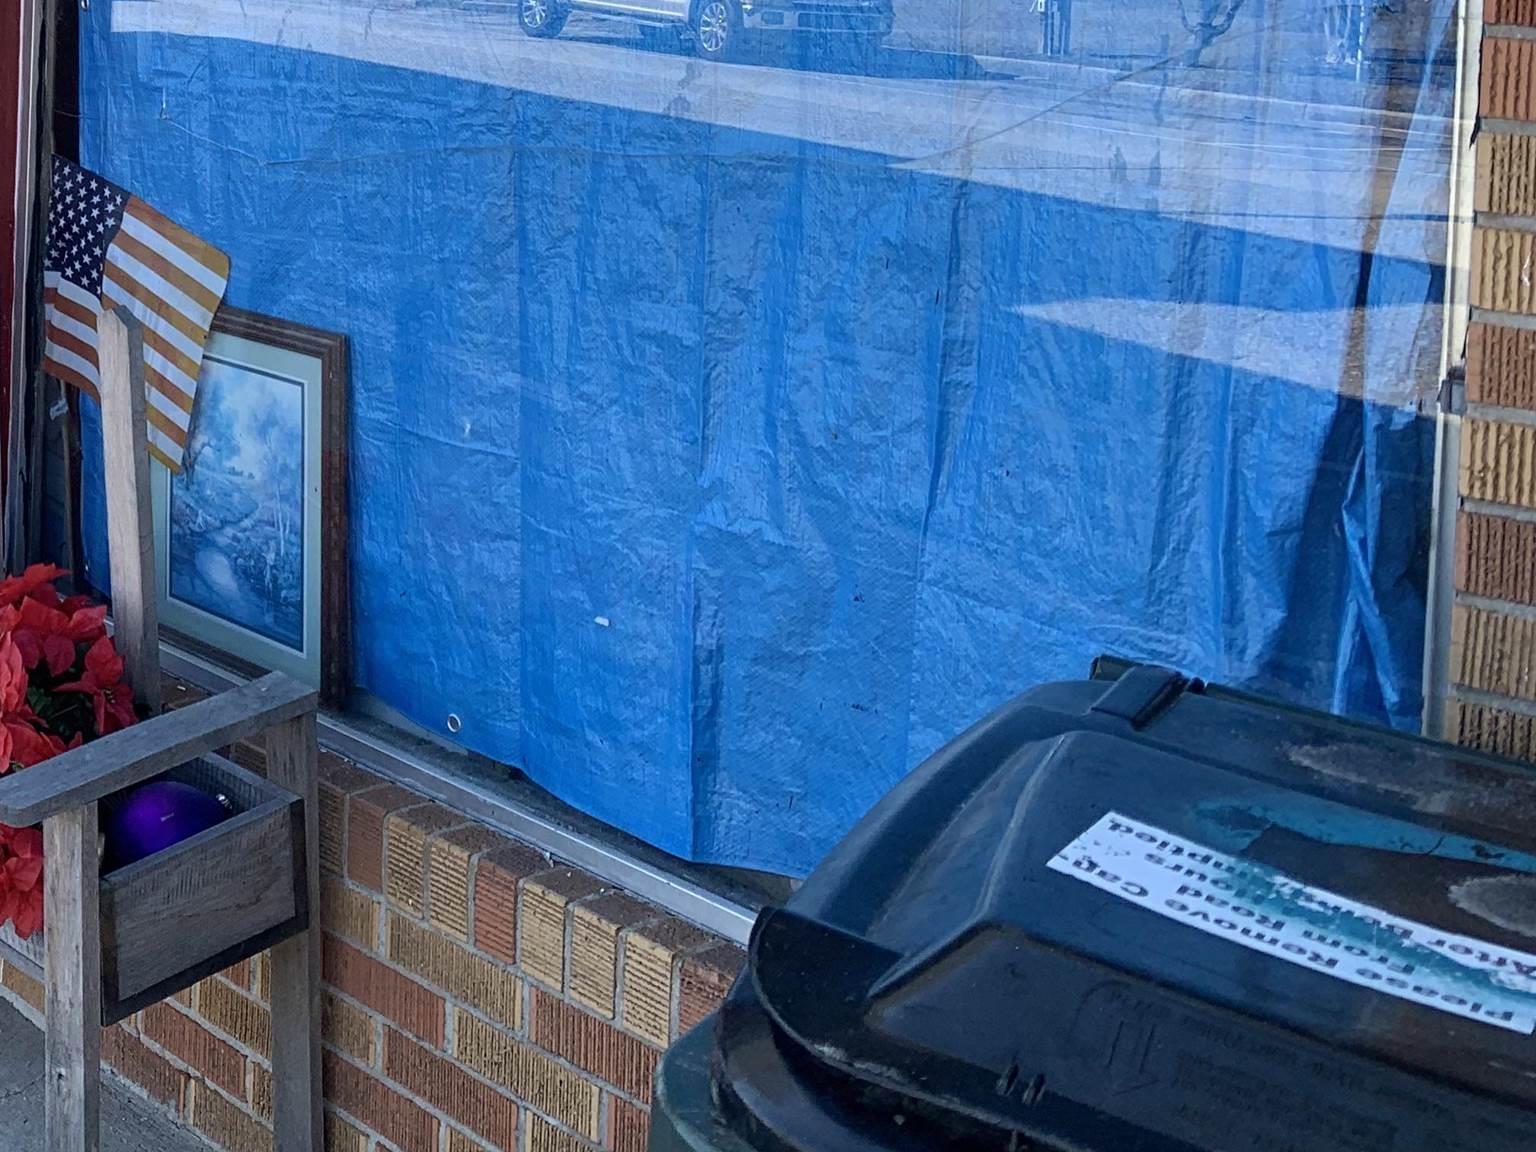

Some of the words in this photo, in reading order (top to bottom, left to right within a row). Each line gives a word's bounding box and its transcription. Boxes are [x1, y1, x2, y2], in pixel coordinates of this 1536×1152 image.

[1165, 898, 1339, 969] Remove
[1176, 884, 1285, 932] Road
[1302, 929, 1415, 975] From
[1356, 967, 1514, 1022] Please
